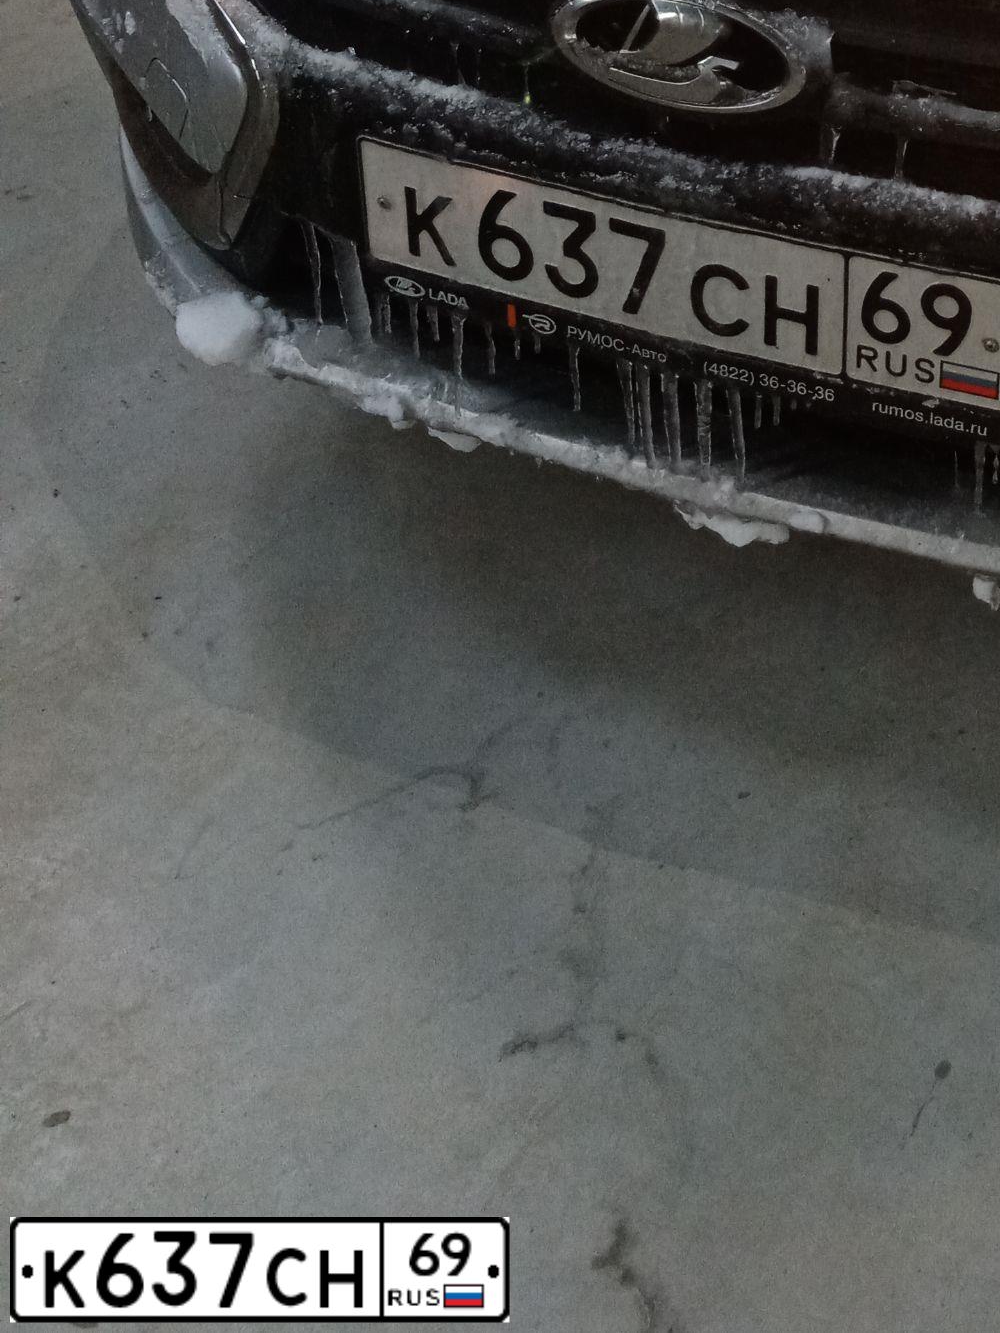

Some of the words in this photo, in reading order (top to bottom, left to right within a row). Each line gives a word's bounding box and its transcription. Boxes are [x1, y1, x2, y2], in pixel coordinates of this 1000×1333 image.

[428, 288, 471, 311] LADA
[861, 271, 973, 357] 69
[703, 361, 755, 386] (4822)
[759, 373, 836, 402] 36-36-36
[855, 344, 936, 384] RUS
[871, 399, 989, 438] rumos.lada.ru
